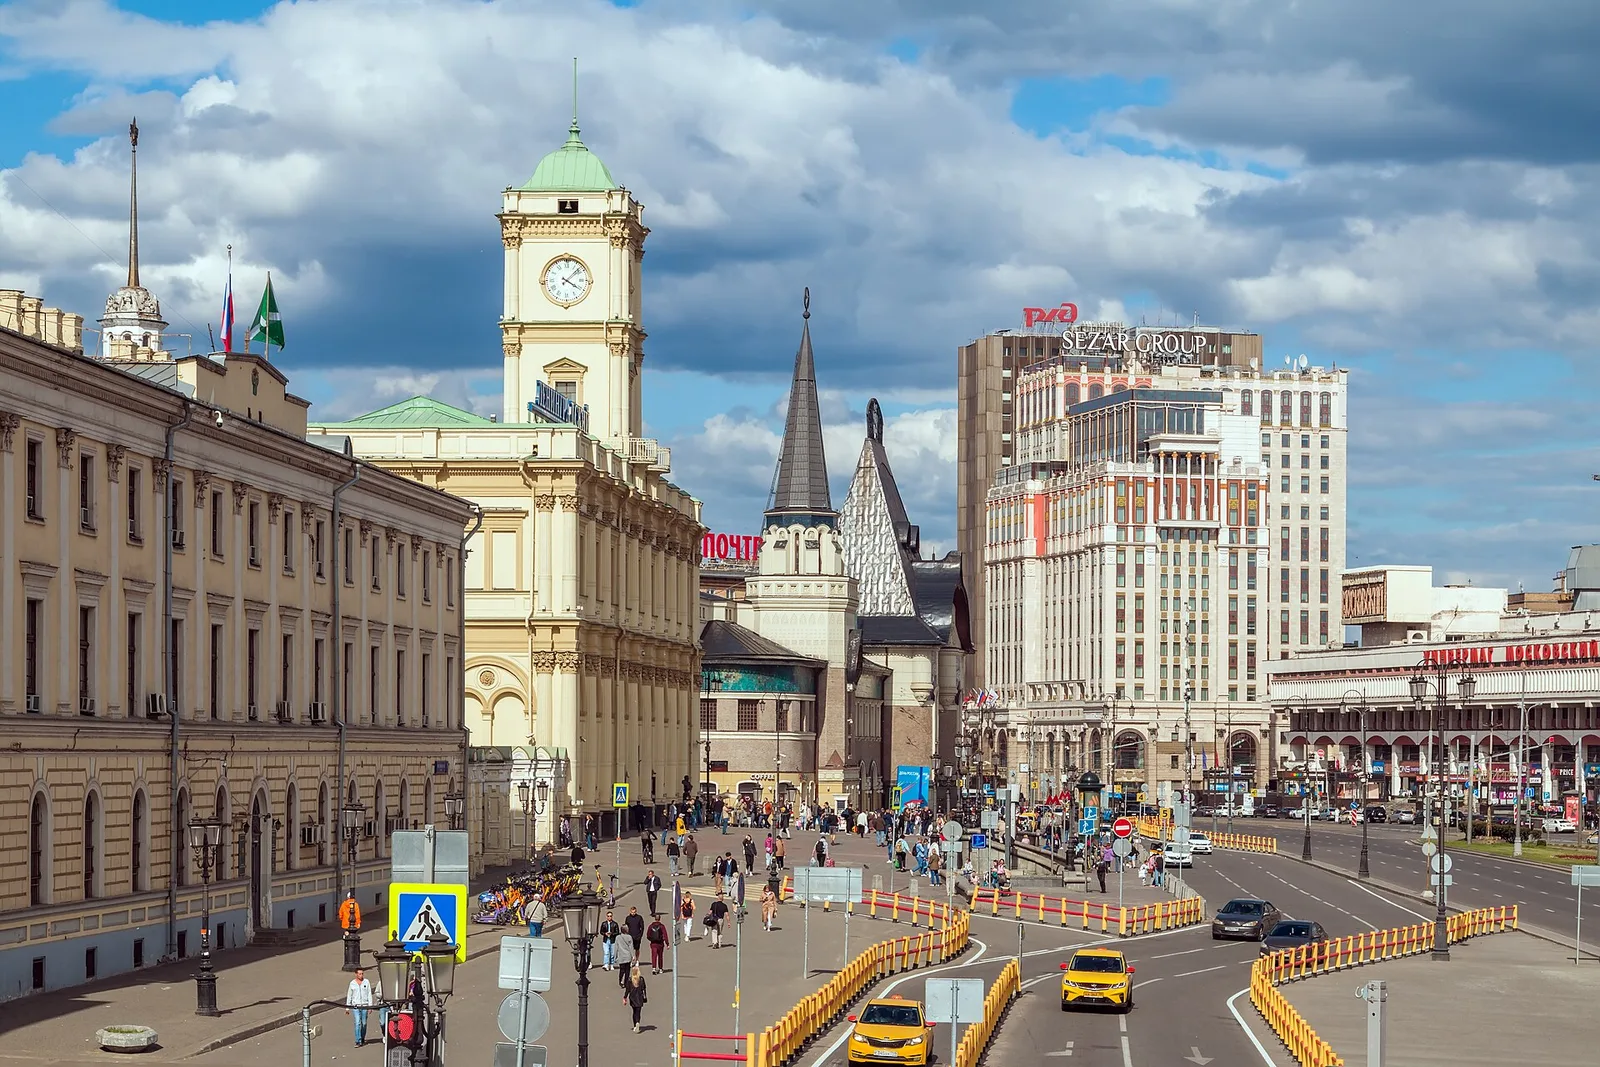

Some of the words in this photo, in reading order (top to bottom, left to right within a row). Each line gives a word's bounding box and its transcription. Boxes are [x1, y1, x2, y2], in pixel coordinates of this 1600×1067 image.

[1062, 330, 1129, 352] SEZAR
[1135, 333, 1207, 354] GROUP
[1505, 639, 1599, 664] МОСКОВСКИЙ
[1162, 809, 1168, 818] 5
